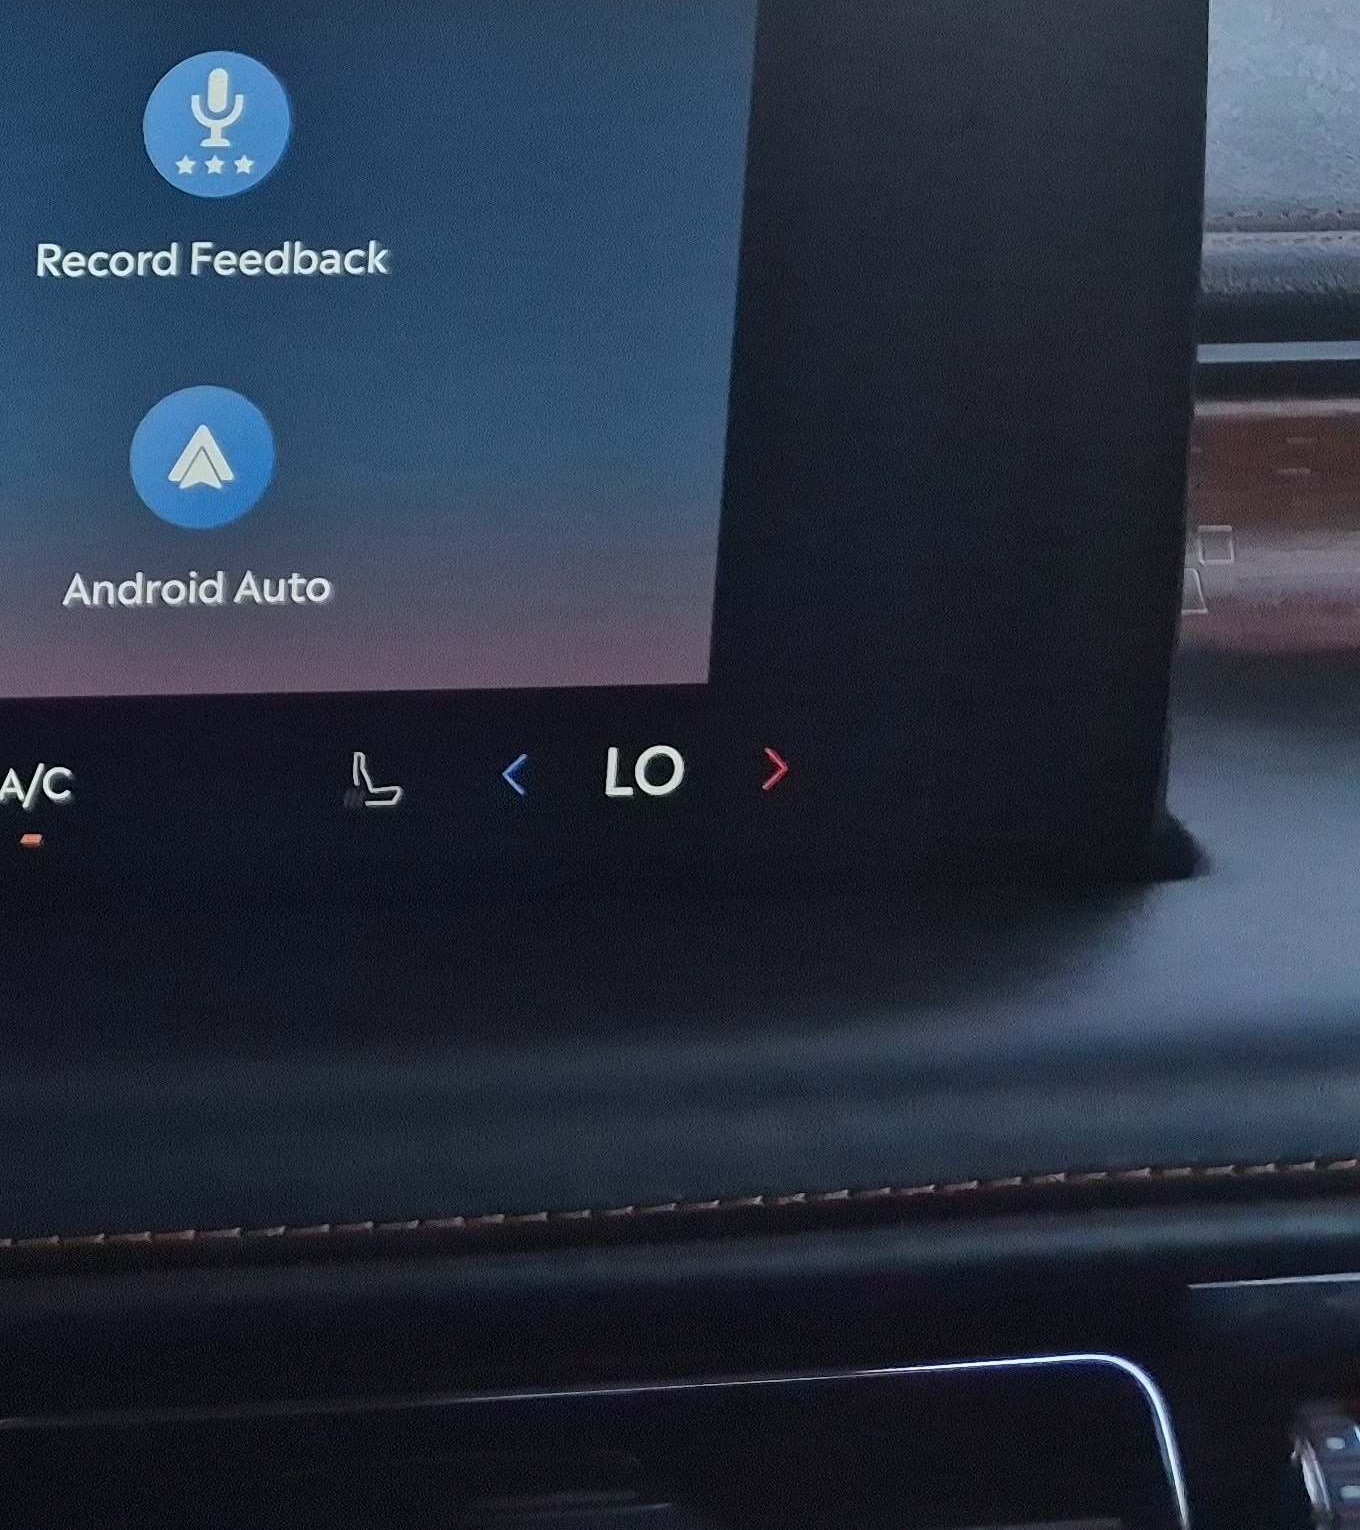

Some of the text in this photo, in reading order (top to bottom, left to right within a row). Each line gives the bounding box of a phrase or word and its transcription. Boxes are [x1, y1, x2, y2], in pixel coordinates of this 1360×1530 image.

[36, 240, 389, 278] Record Feedback
[62, 570, 332, 607] Android Auto
[605, 744, 685, 797] LO
